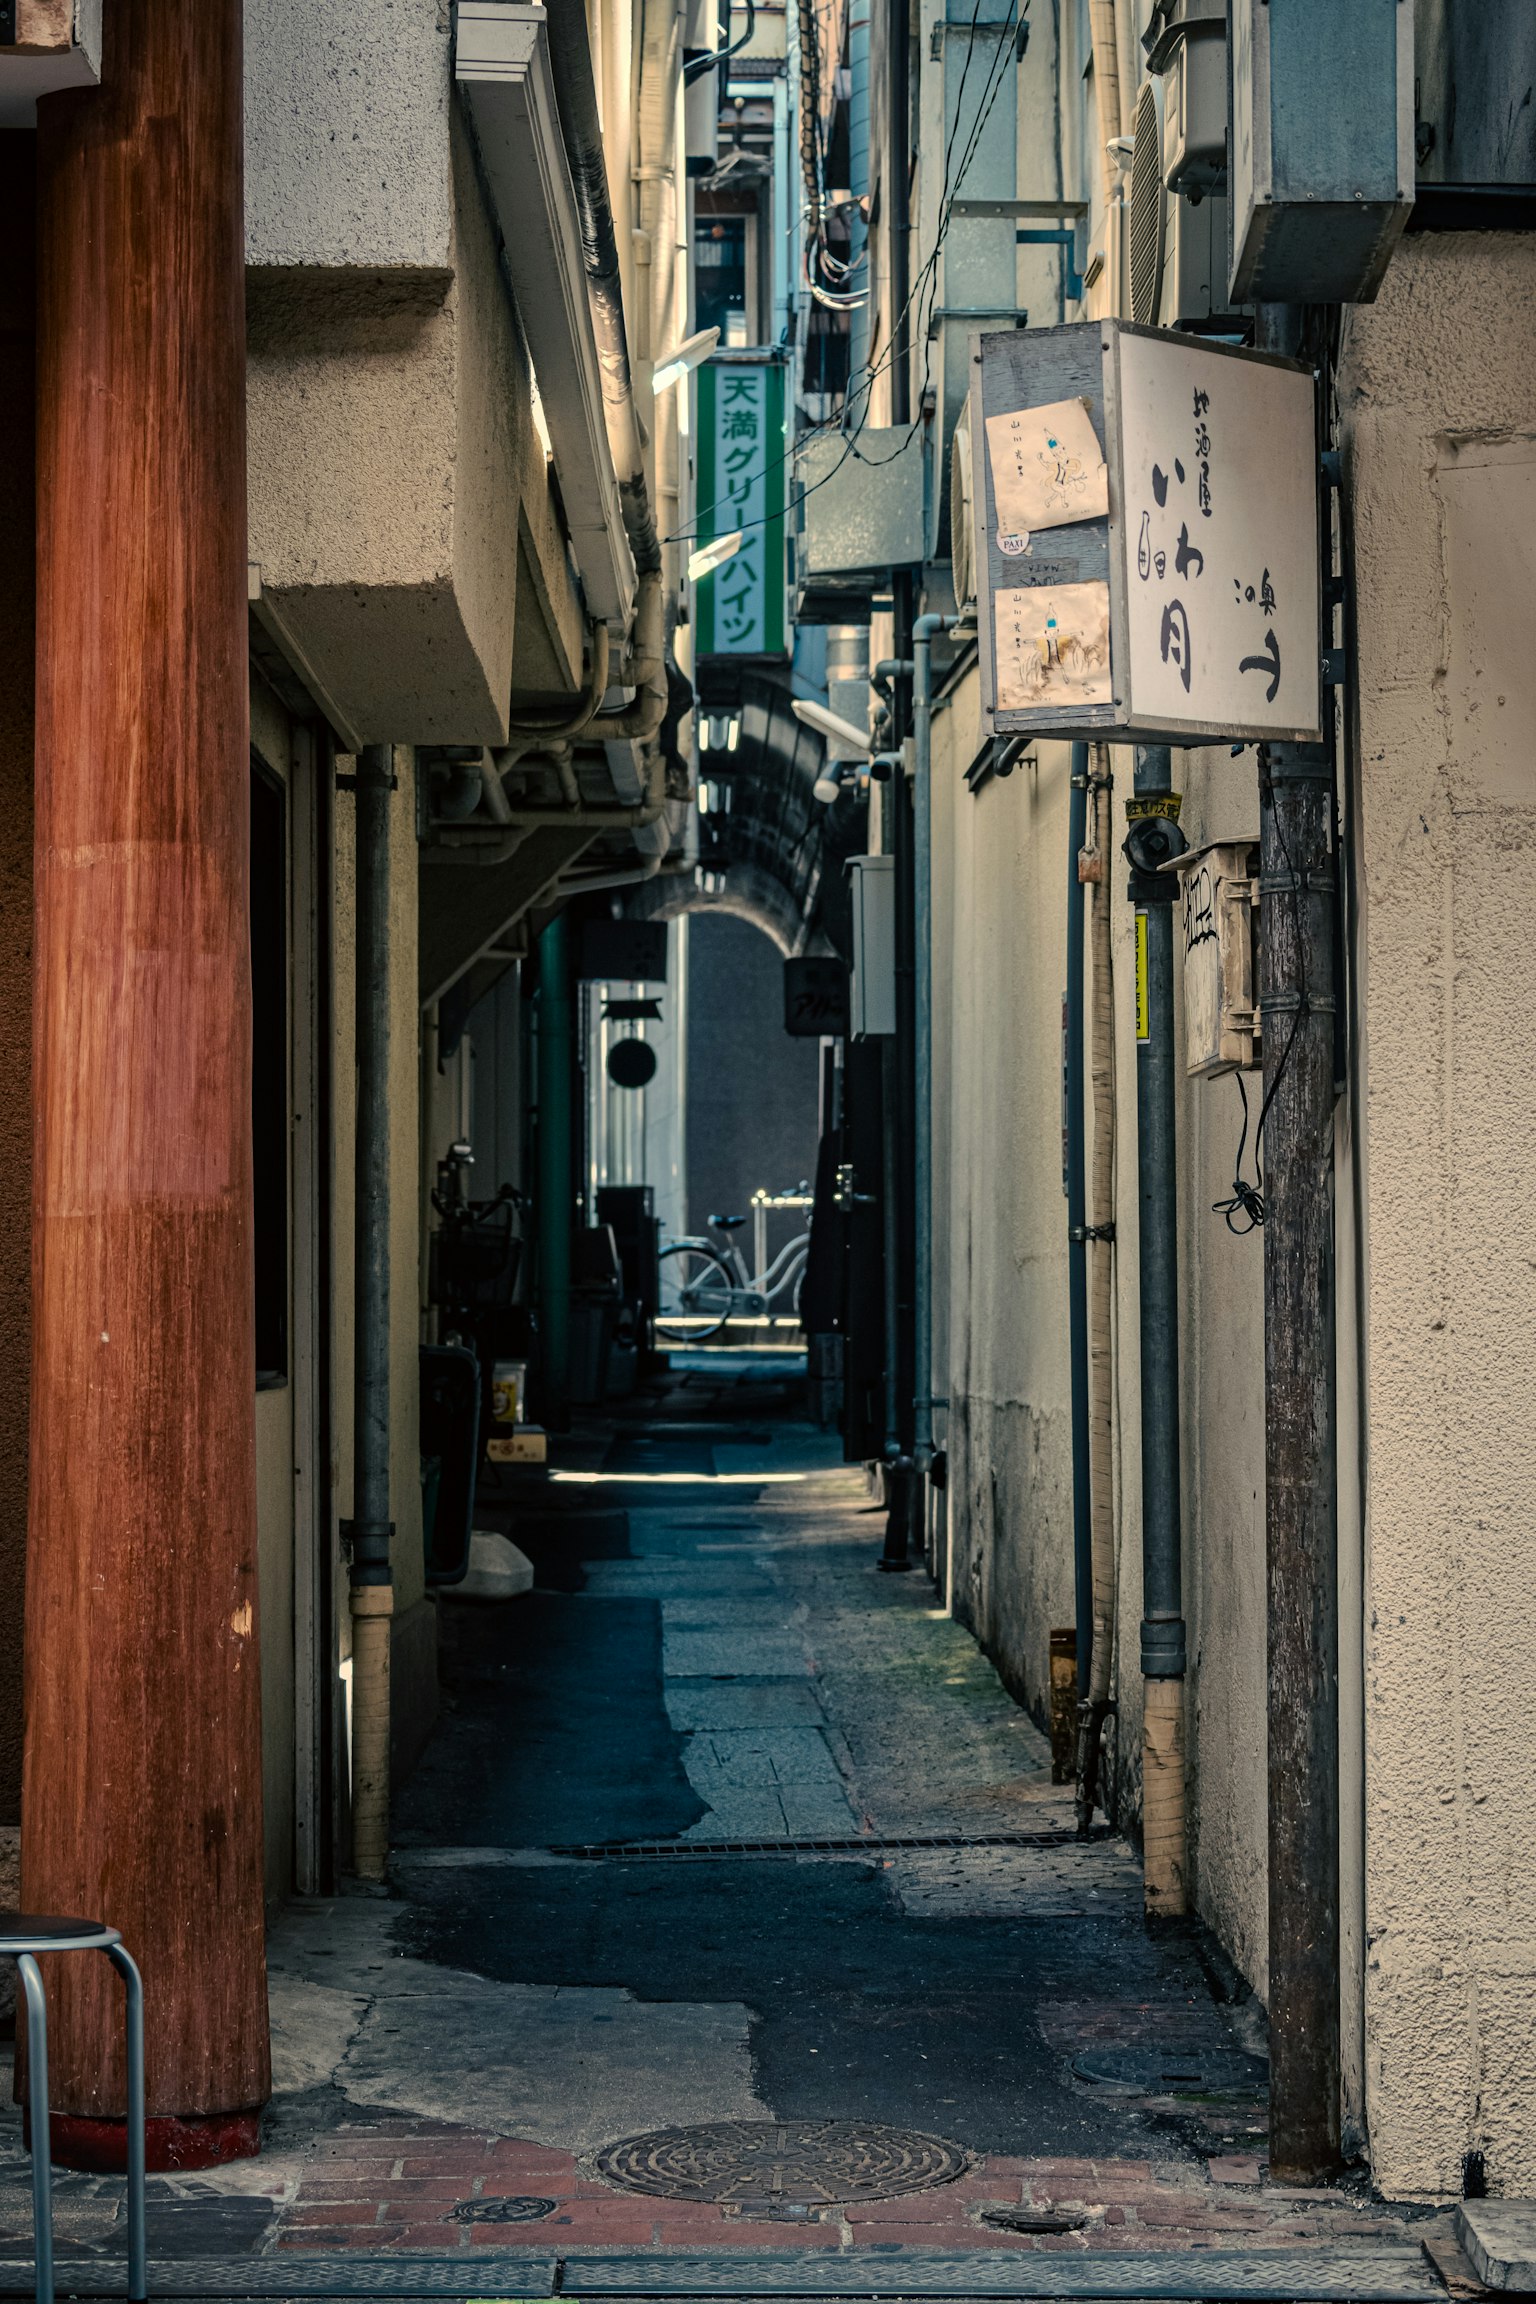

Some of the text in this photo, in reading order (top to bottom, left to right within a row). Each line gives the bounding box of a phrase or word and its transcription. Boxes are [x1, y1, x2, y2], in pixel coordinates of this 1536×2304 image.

[1192, 385, 1213, 518] 地酒屋
[1151, 457, 1205, 694] いわ月
